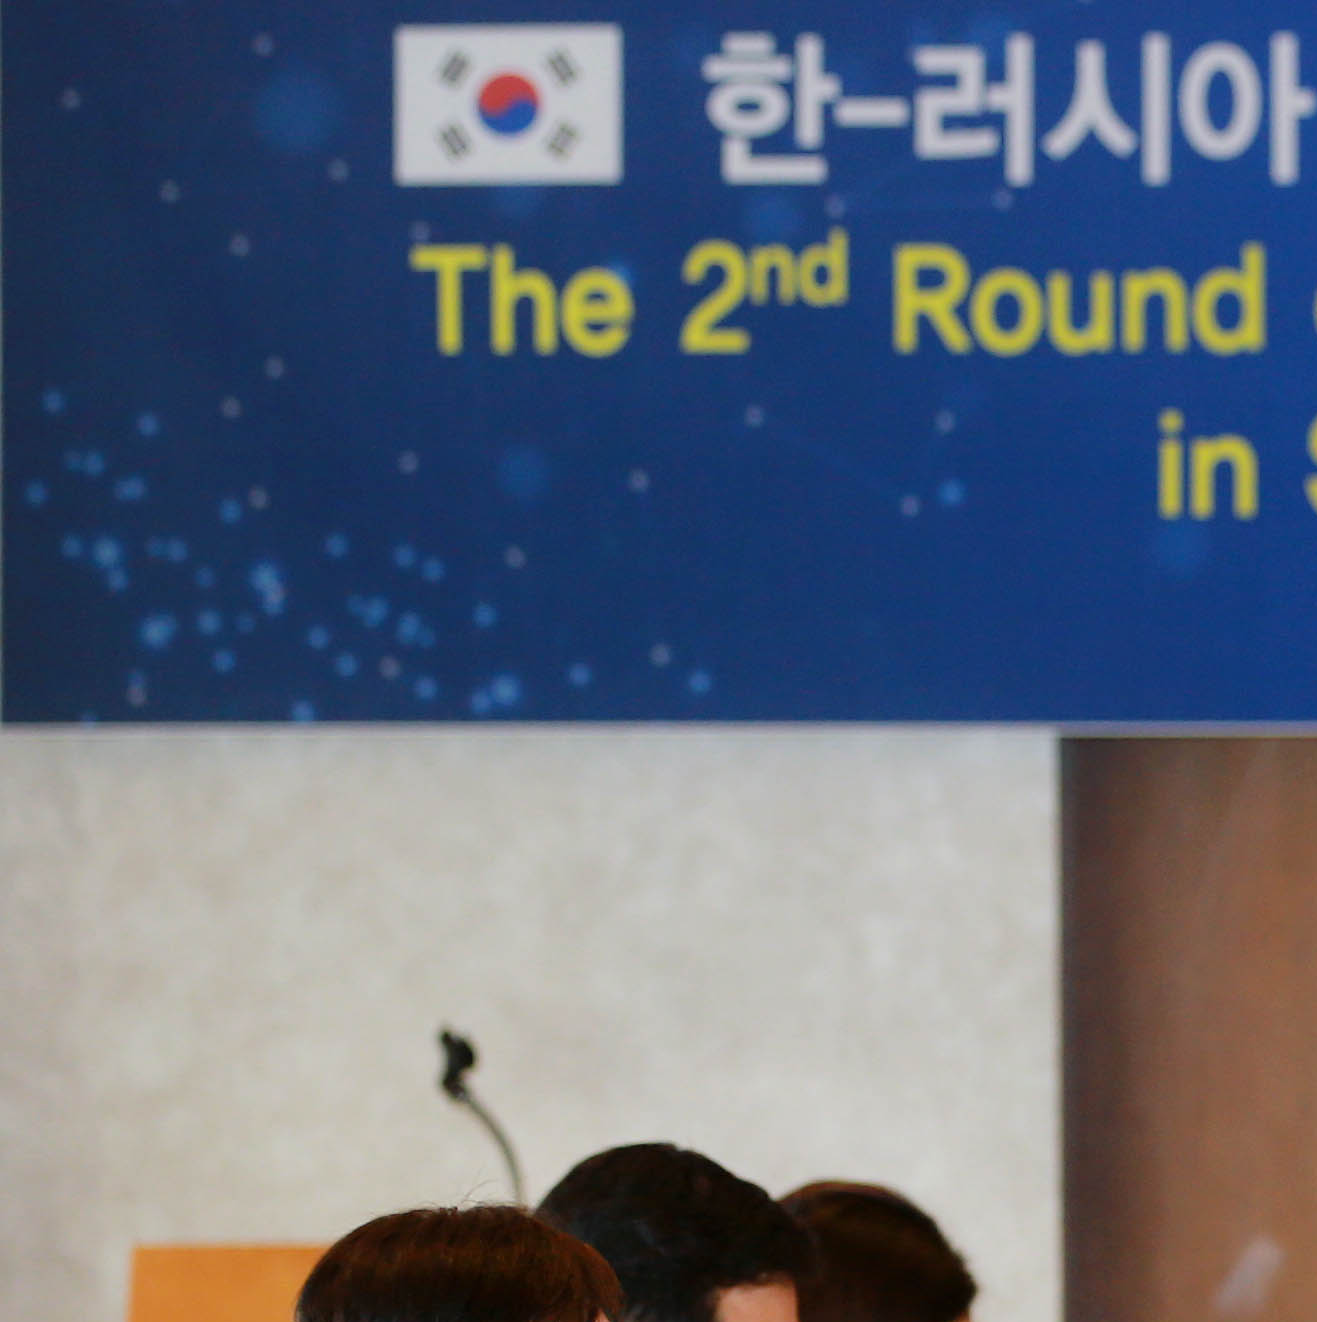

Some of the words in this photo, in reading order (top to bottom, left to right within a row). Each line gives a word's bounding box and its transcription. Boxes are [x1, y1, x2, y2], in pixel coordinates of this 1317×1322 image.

[702, 32, 1317, 187] 한-러시아
[410, 244, 634, 357] The
[681, 228, 849, 354] 2nd
[893, 243, 1266, 356] Round
[1158, 409, 1258, 519] in
